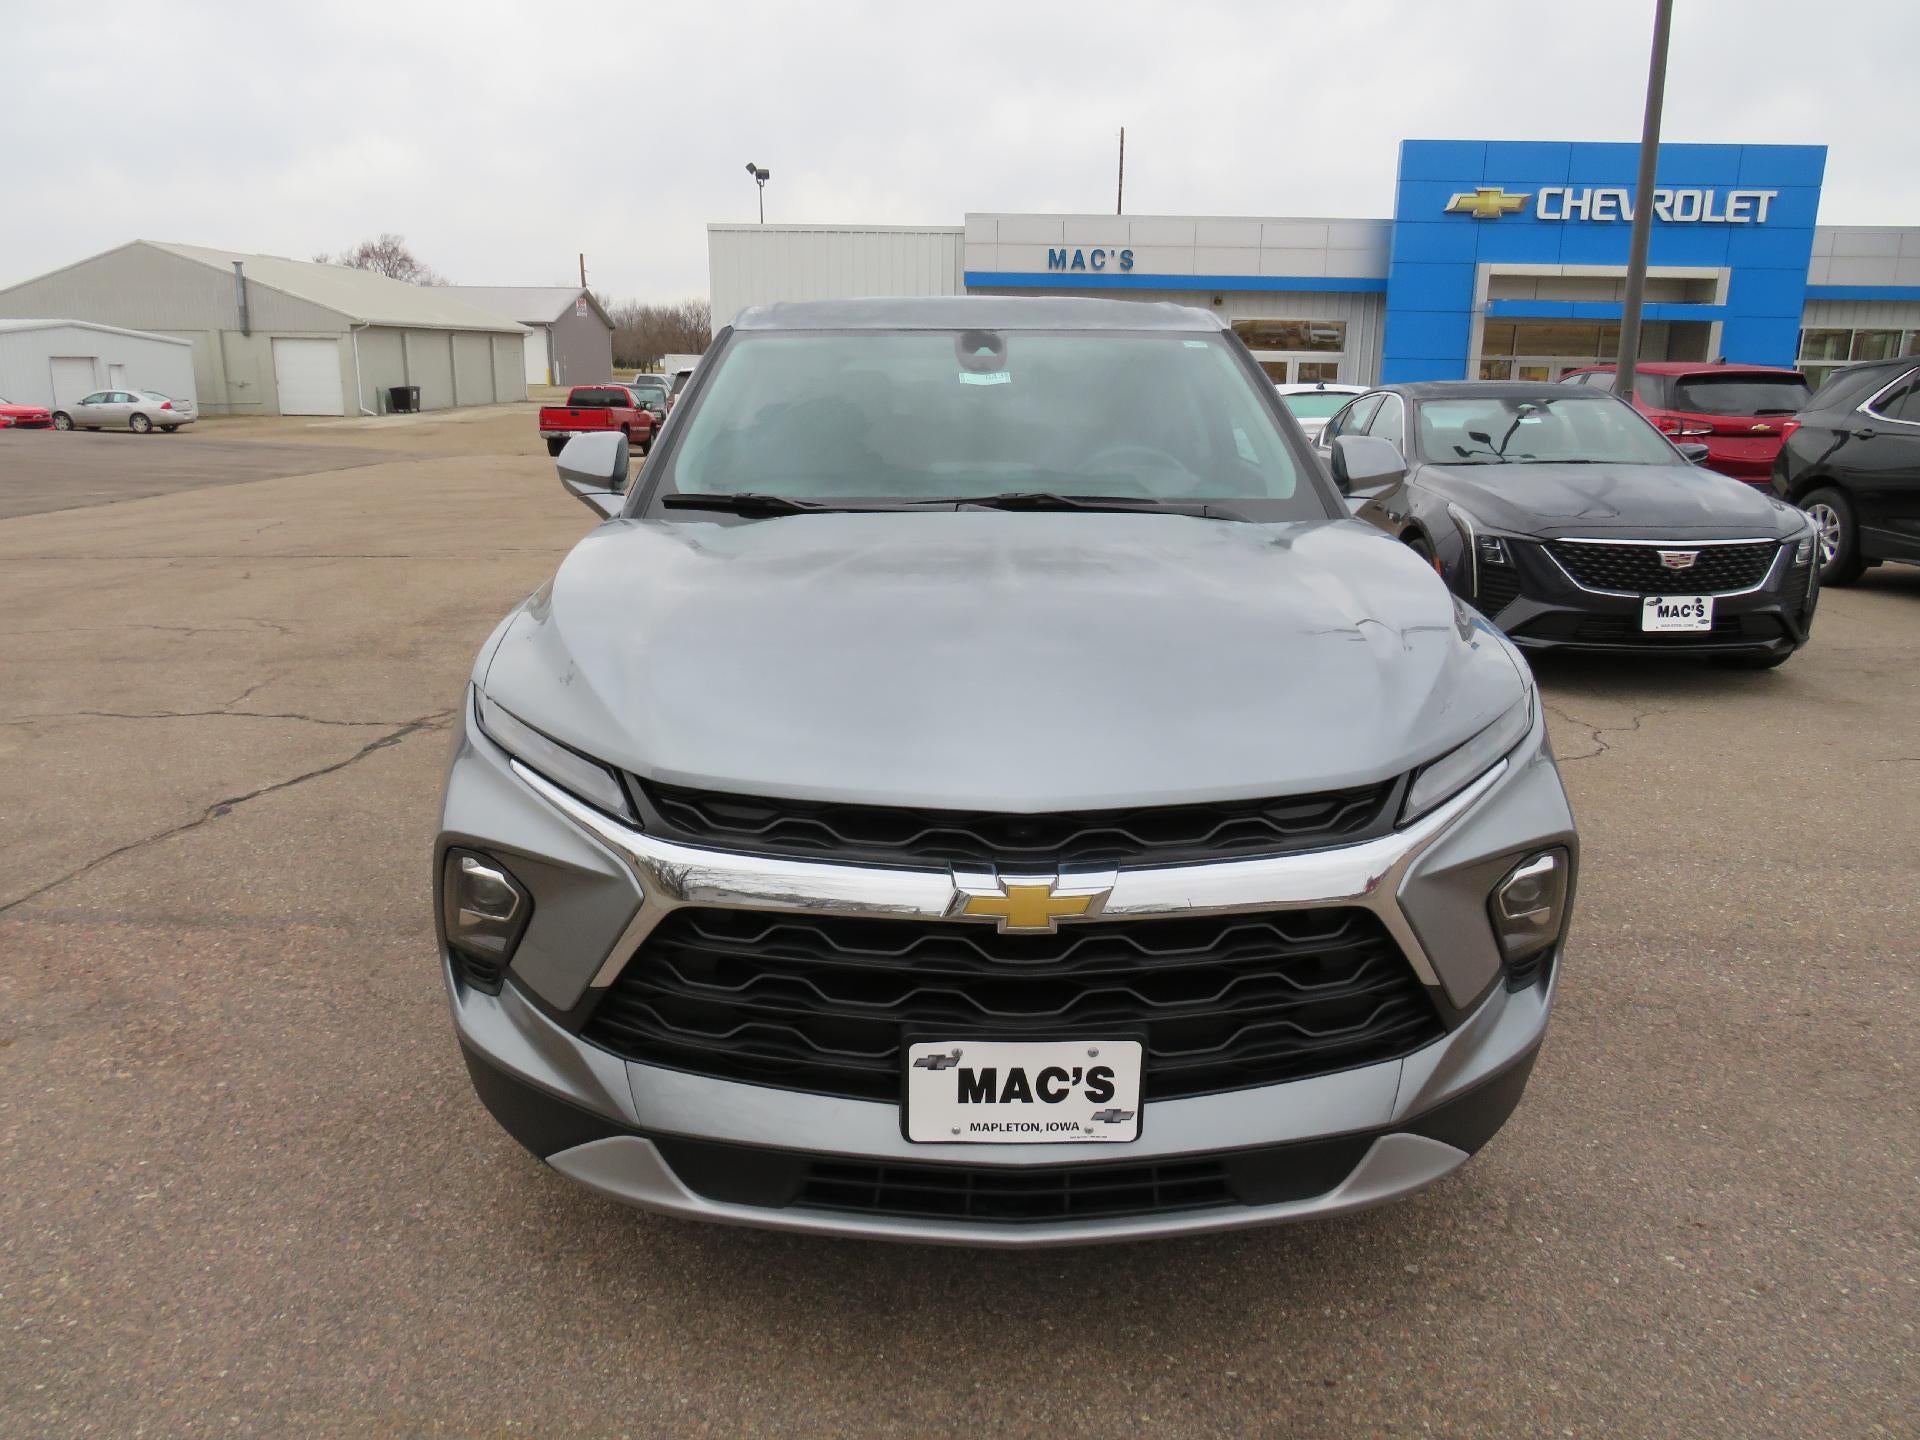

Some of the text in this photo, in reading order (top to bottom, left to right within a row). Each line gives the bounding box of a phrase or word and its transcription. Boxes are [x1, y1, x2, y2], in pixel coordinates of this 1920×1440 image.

[1536, 187, 1778, 223] CHEVROLET
[1048, 248, 1134, 271] MAC'S
[1657, 604, 1705, 618] MAC'S
[957, 1065, 1115, 1104] MAC'S
[969, 1122, 1080, 1133] MAPLETON, IOWA
